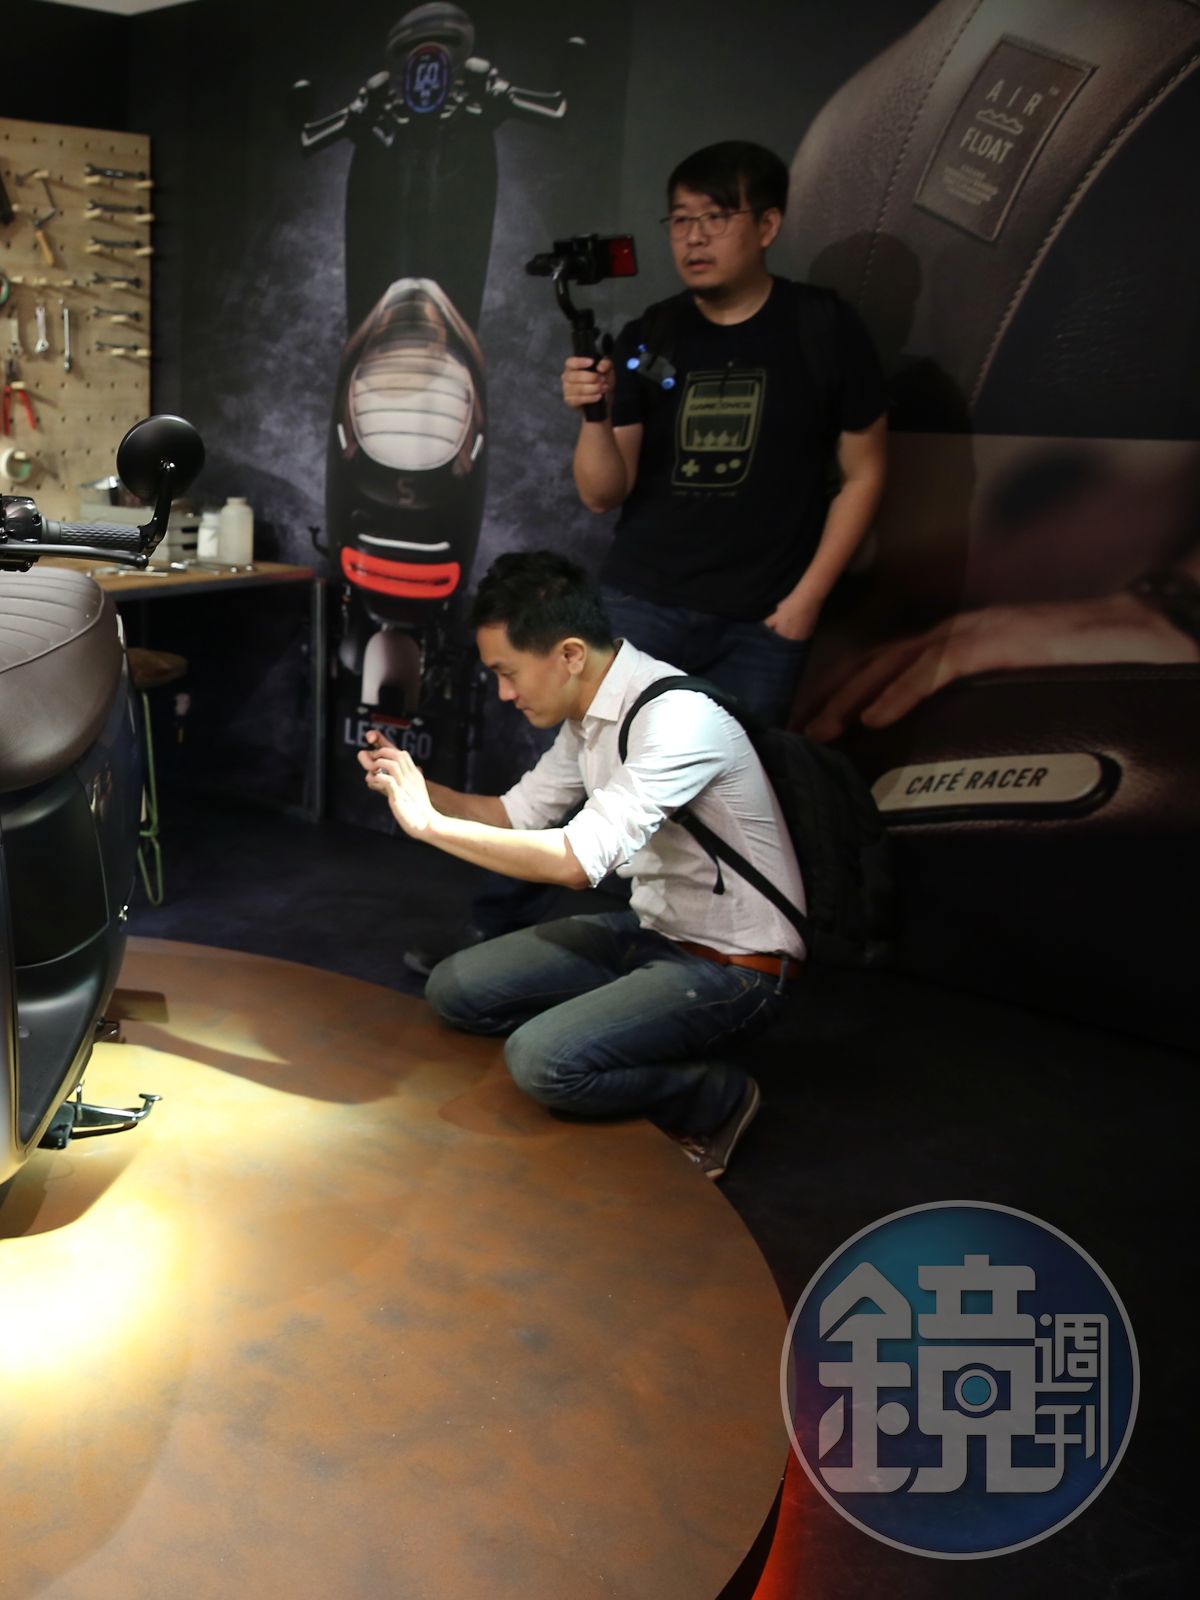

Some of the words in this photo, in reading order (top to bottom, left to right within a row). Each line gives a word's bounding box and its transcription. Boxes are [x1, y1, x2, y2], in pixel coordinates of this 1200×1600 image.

[985, 79, 1043, 116] AIR
[960, 127, 1015, 164] FLOAT
[905, 767, 965, 796] CAFÉ
[964, 767, 1049, 791] RACER
